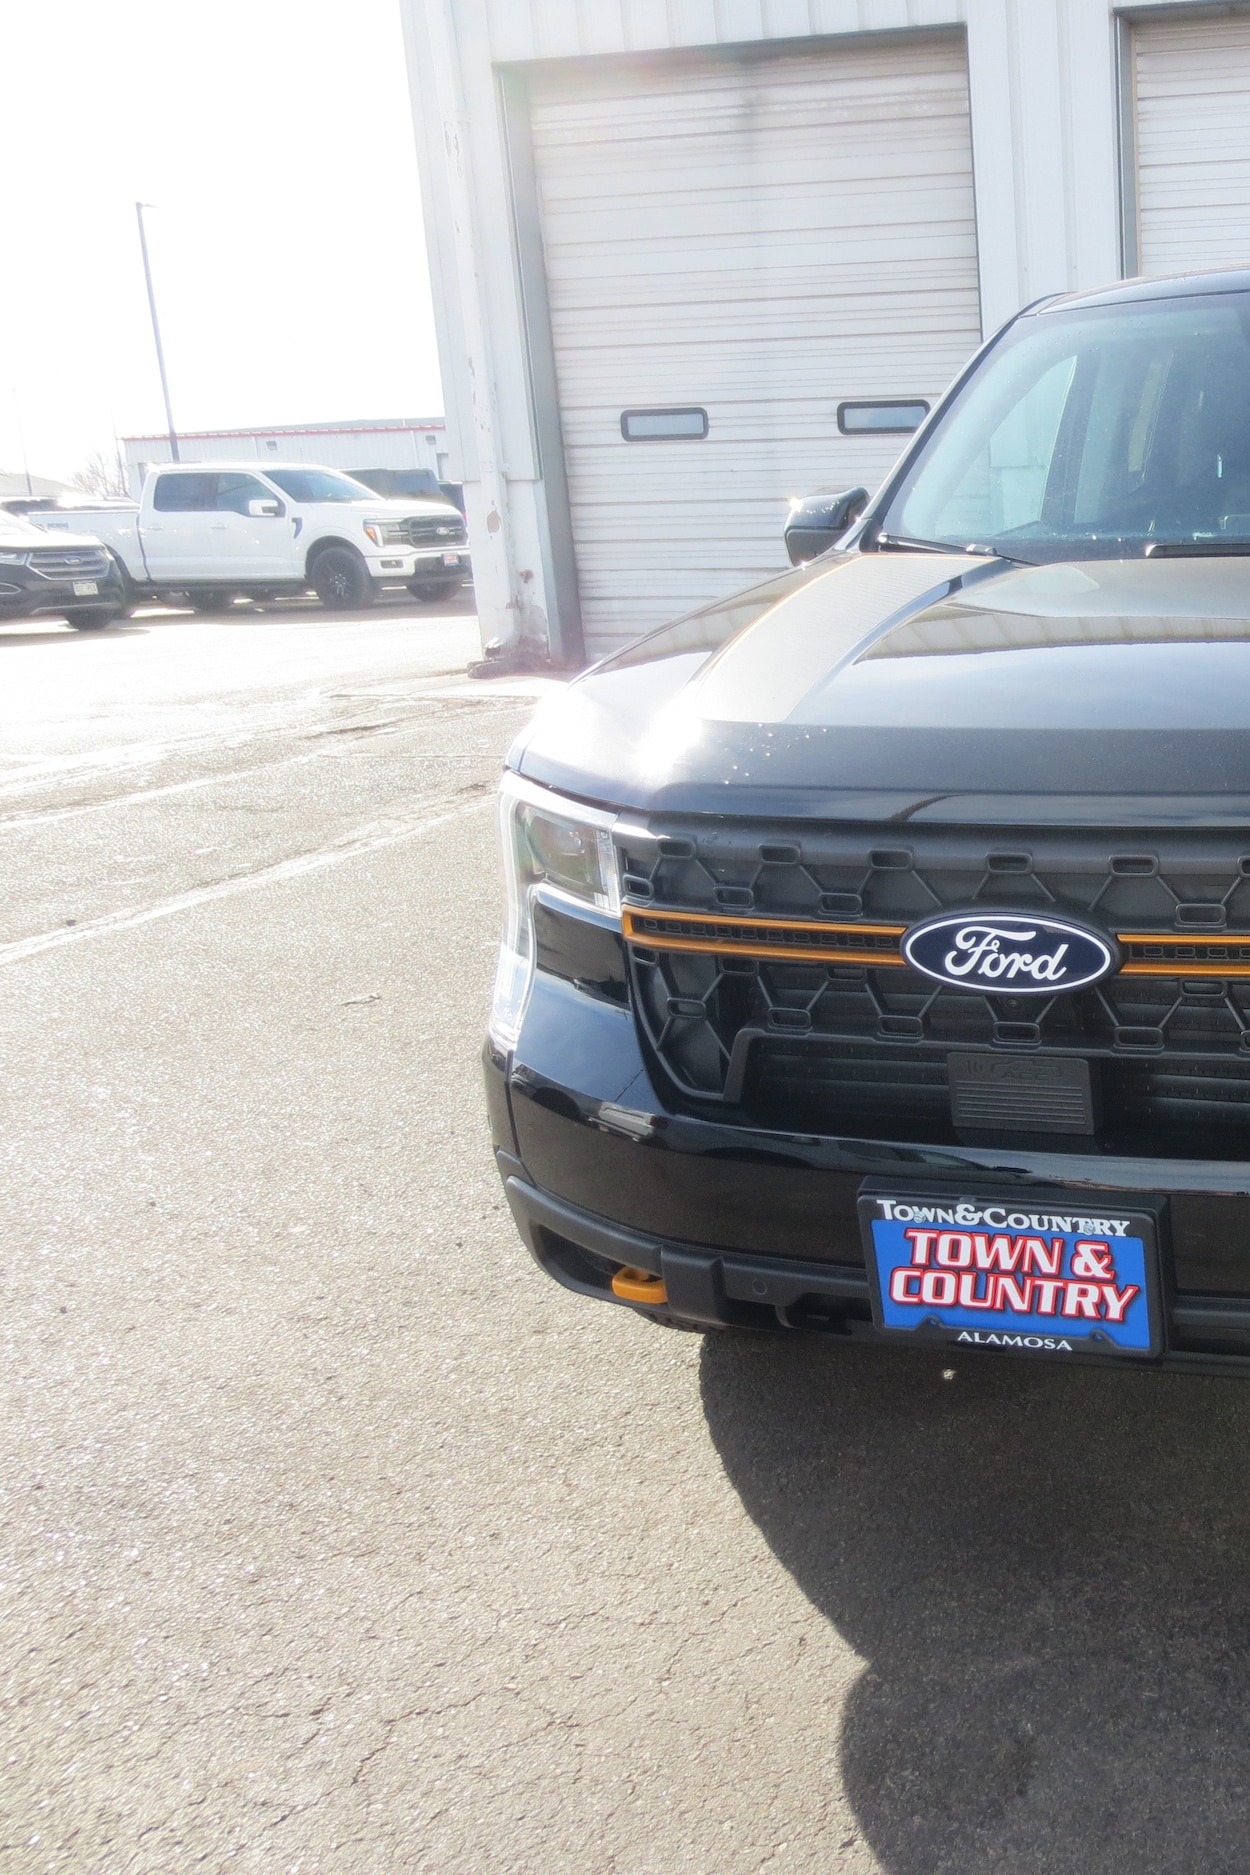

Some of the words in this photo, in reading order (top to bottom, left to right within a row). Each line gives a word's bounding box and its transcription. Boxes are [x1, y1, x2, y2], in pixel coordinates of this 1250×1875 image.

[944, 926, 1069, 980] Ford
[905, 1228, 1063, 1276] TOWN
[1071, 1240, 1115, 1280] &
[890, 1267, 1139, 1321] COUNTRY
[957, 1330, 1073, 1351] ALAMOSA
